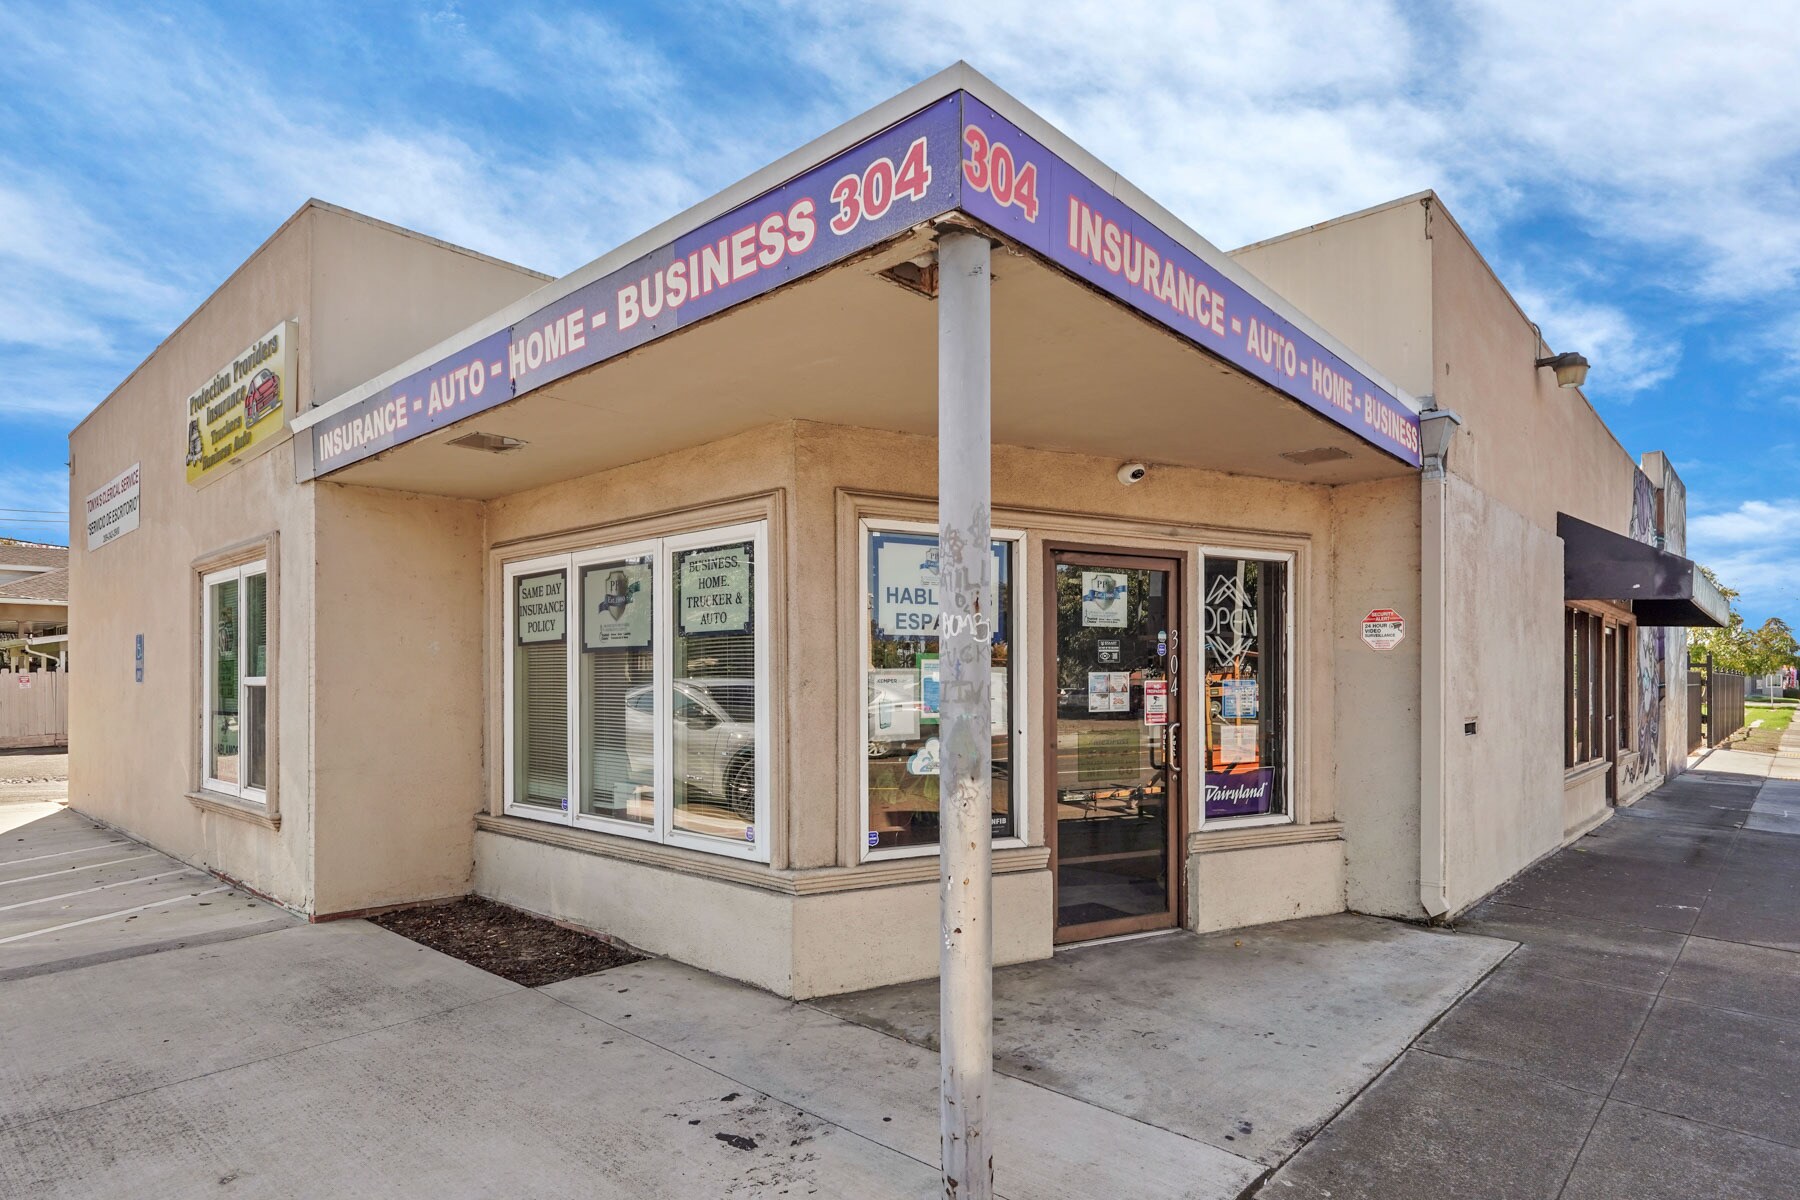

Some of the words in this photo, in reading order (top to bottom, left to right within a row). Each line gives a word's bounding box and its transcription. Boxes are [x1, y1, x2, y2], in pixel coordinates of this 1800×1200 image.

[319, 396, 408, 462] INSURANCE
[427, 359, 484, 418] AUTO
[508, 309, 587, 381] HOME
[617, 197, 817, 331] BUSINESS
[829, 136, 932, 236] 304
[962, 124, 1039, 224] 304
[1067, 195, 1226, 338] INSURANCE
[1246, 316, 1297, 378] AUTO
[1312, 357, 1353, 413] HOME
[1364, 393, 1418, 454] BUSINESS
[189, 372, 231, 416] Protection
[233, 335, 279, 383] Providers
[206, 384, 247, 425] Insurance
[121, 469, 139, 494] SERVICE
[521, 584, 544, 600] SAME
[545, 582, 562, 598] DAY
[686, 593, 733, 610] TRUCKER
[735, 591, 743, 605] &
[886, 586, 941, 605] HABL
[519, 600, 565, 617] INSURANCE
[700, 611, 728, 626] AUTO
[527, 619, 556, 634] POLICY
[1205, 605, 1257, 636] OPEN
[1205, 782, 1266, 804] Dairyland
